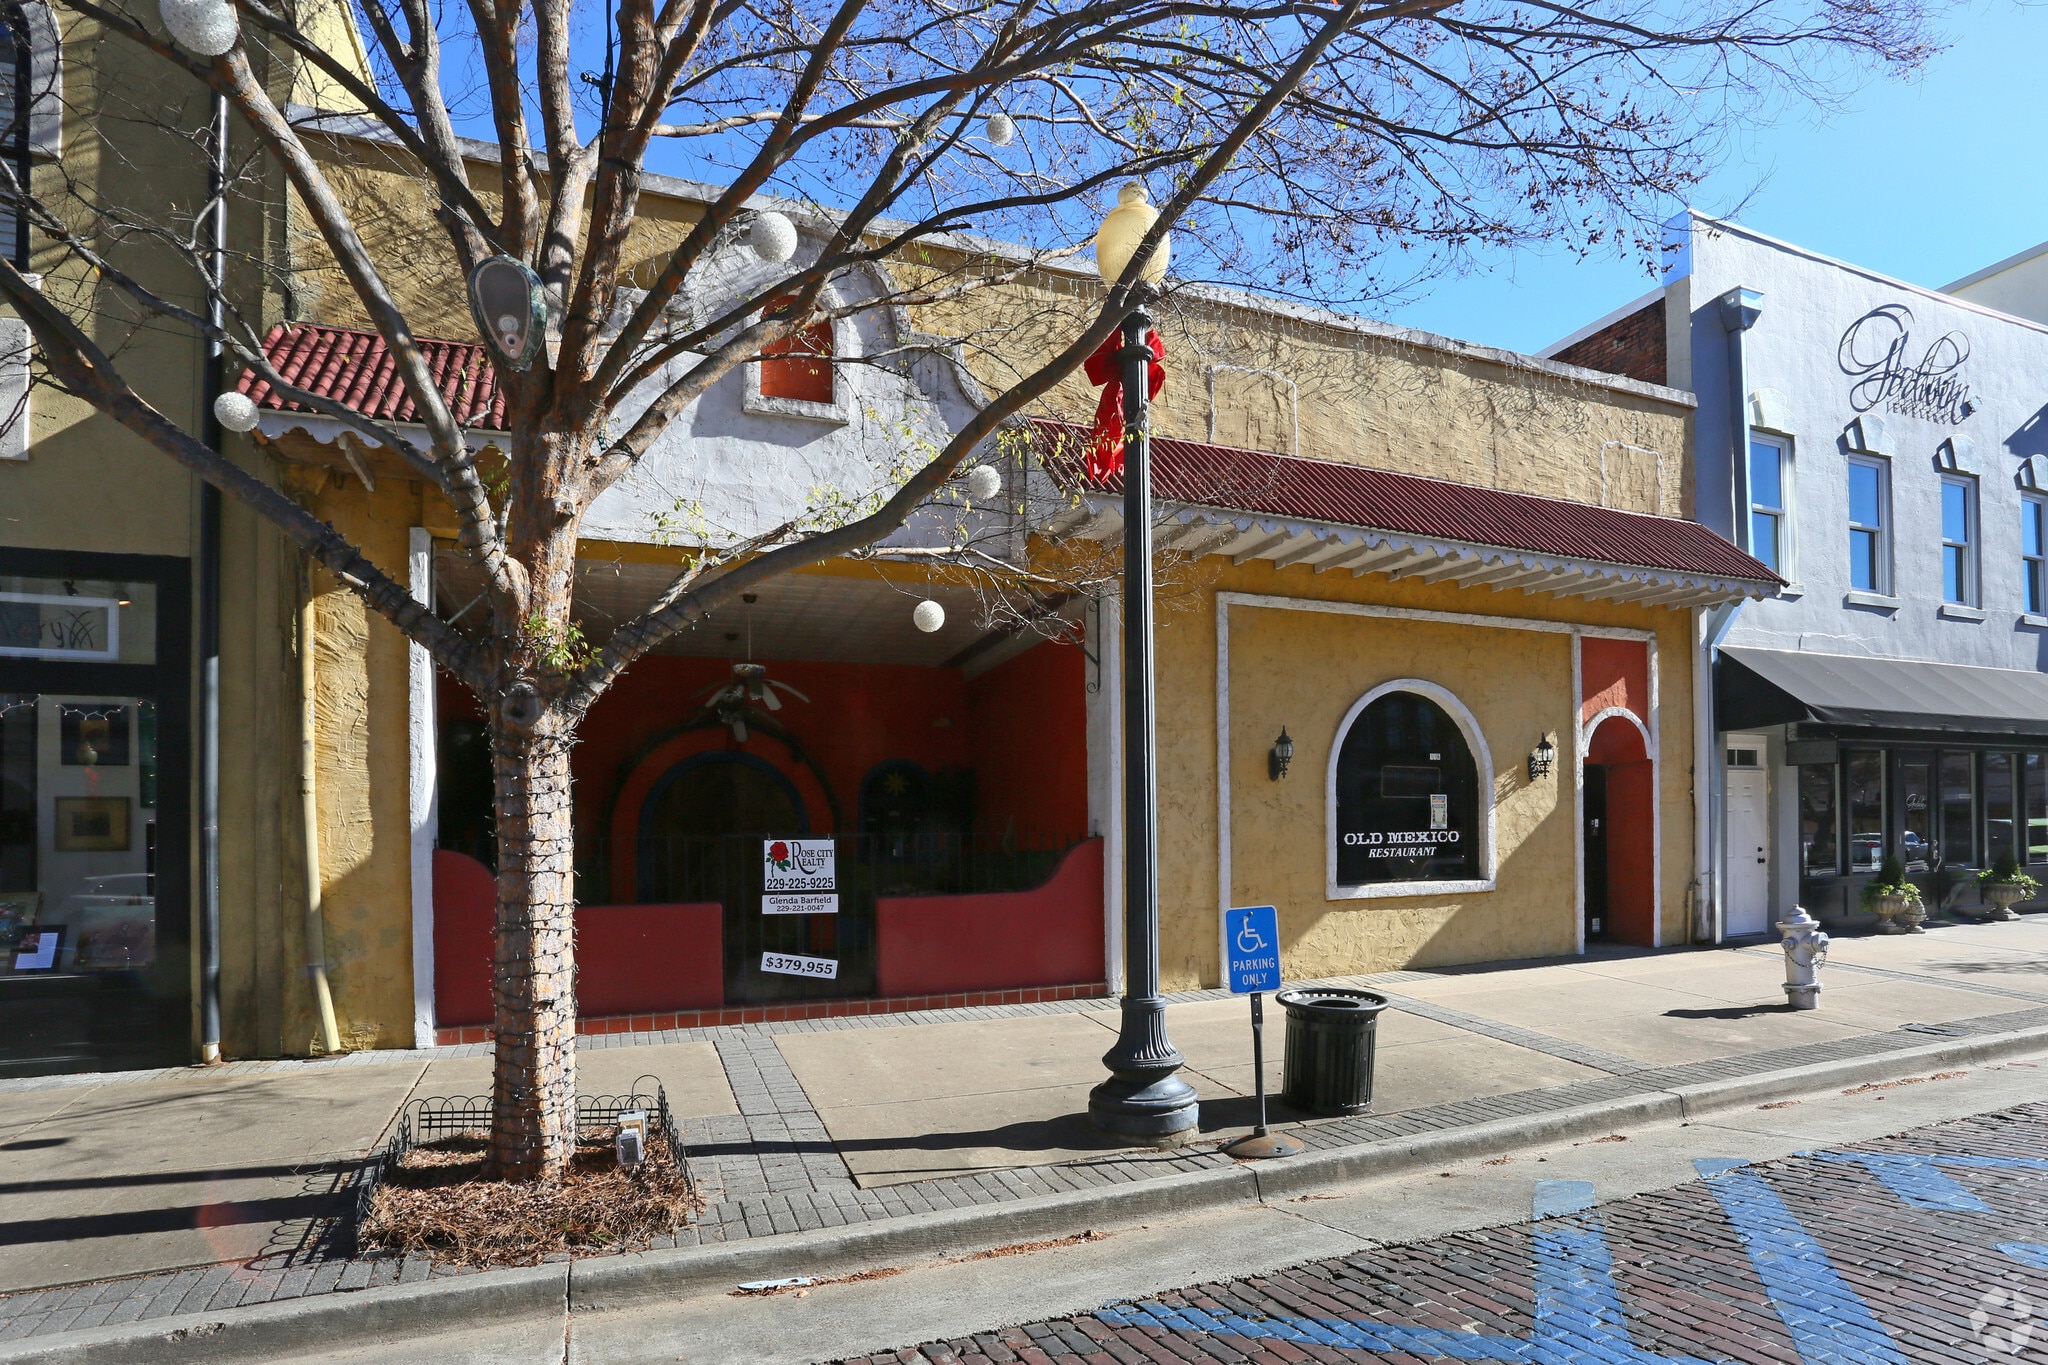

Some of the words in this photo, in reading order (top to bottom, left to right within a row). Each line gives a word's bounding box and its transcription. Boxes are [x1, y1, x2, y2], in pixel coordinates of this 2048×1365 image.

[1344, 832, 1383, 845] OLD
[1387, 831, 1460, 844] MEXICO
[817, 849, 834, 857] CITY
[1368, 847, 1437, 858] RESTAURANT
[766, 877, 834, 890] 229-225-9225
[769, 897, 798, 905] Glenda
[801, 896, 832, 904] Barfield
[776, 904, 824, 912] 229-221-0047
[766, 956, 833, 974] $379,955
[1233, 957, 1275, 972] PARKING
[1242, 972, 1267, 985] ONLY
